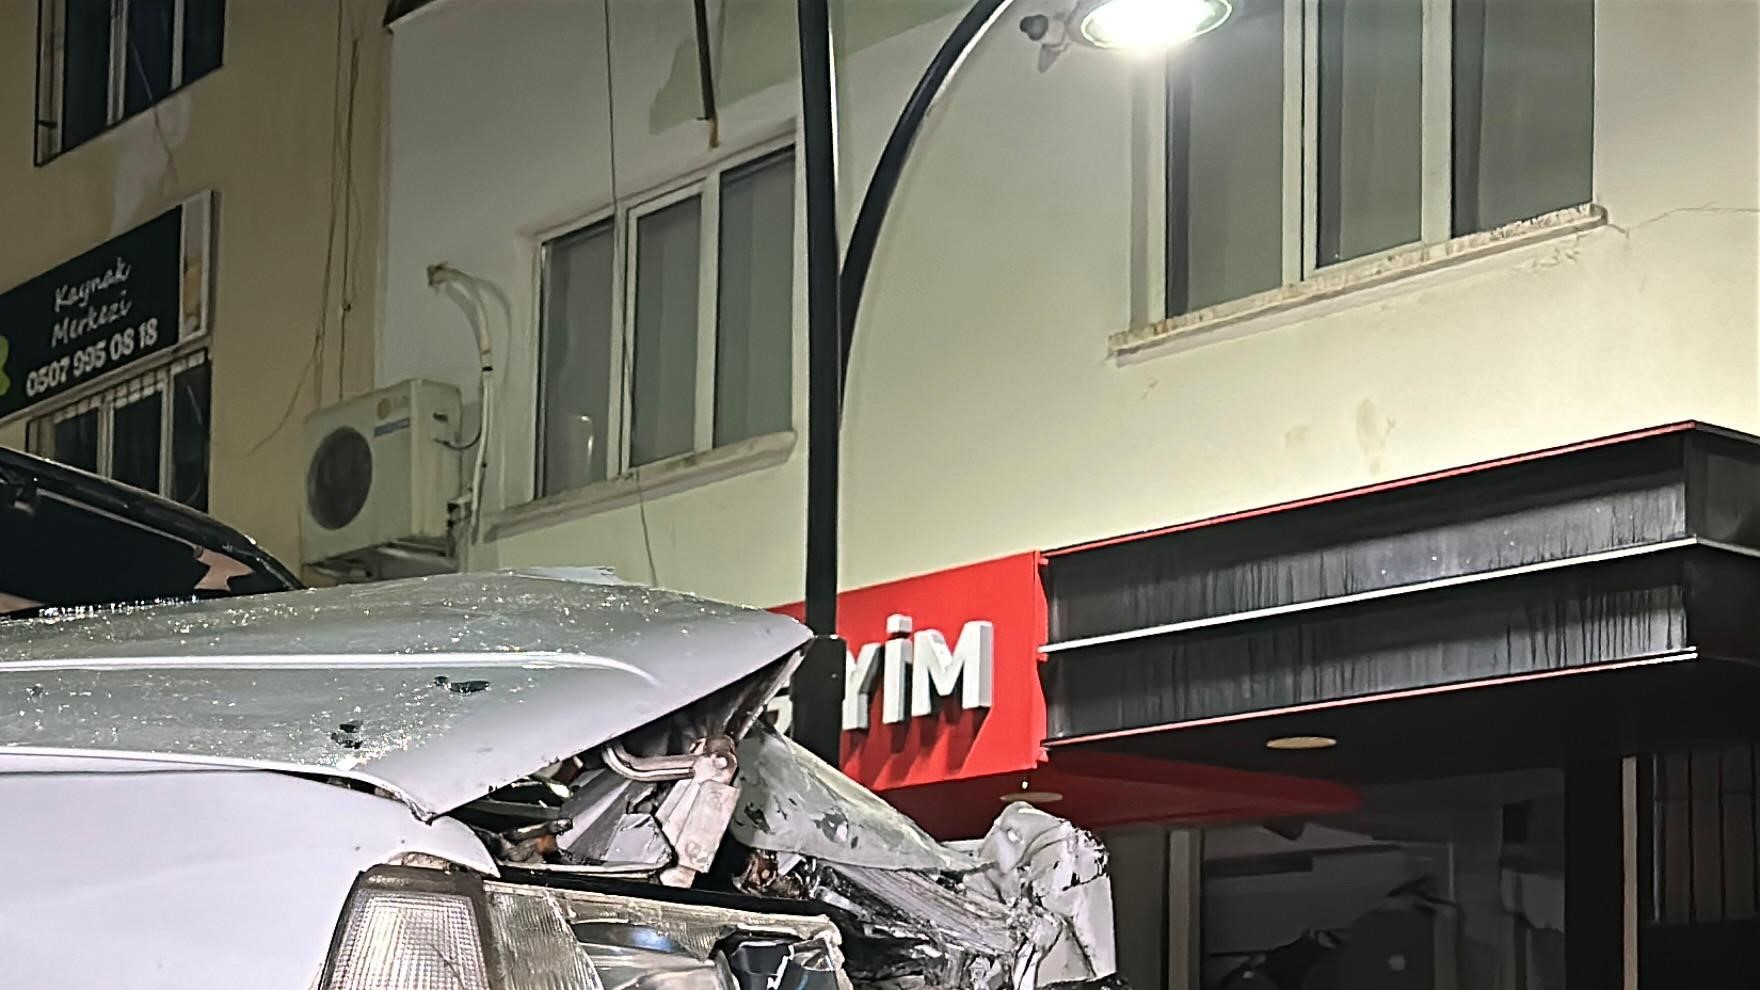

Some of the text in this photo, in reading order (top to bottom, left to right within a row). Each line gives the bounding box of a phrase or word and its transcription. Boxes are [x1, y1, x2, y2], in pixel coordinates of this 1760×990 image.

[54, 256, 131, 312] Kaynak
[51, 289, 131, 347] Merkezi
[26, 317, 159, 398] 0507 995 08 18
